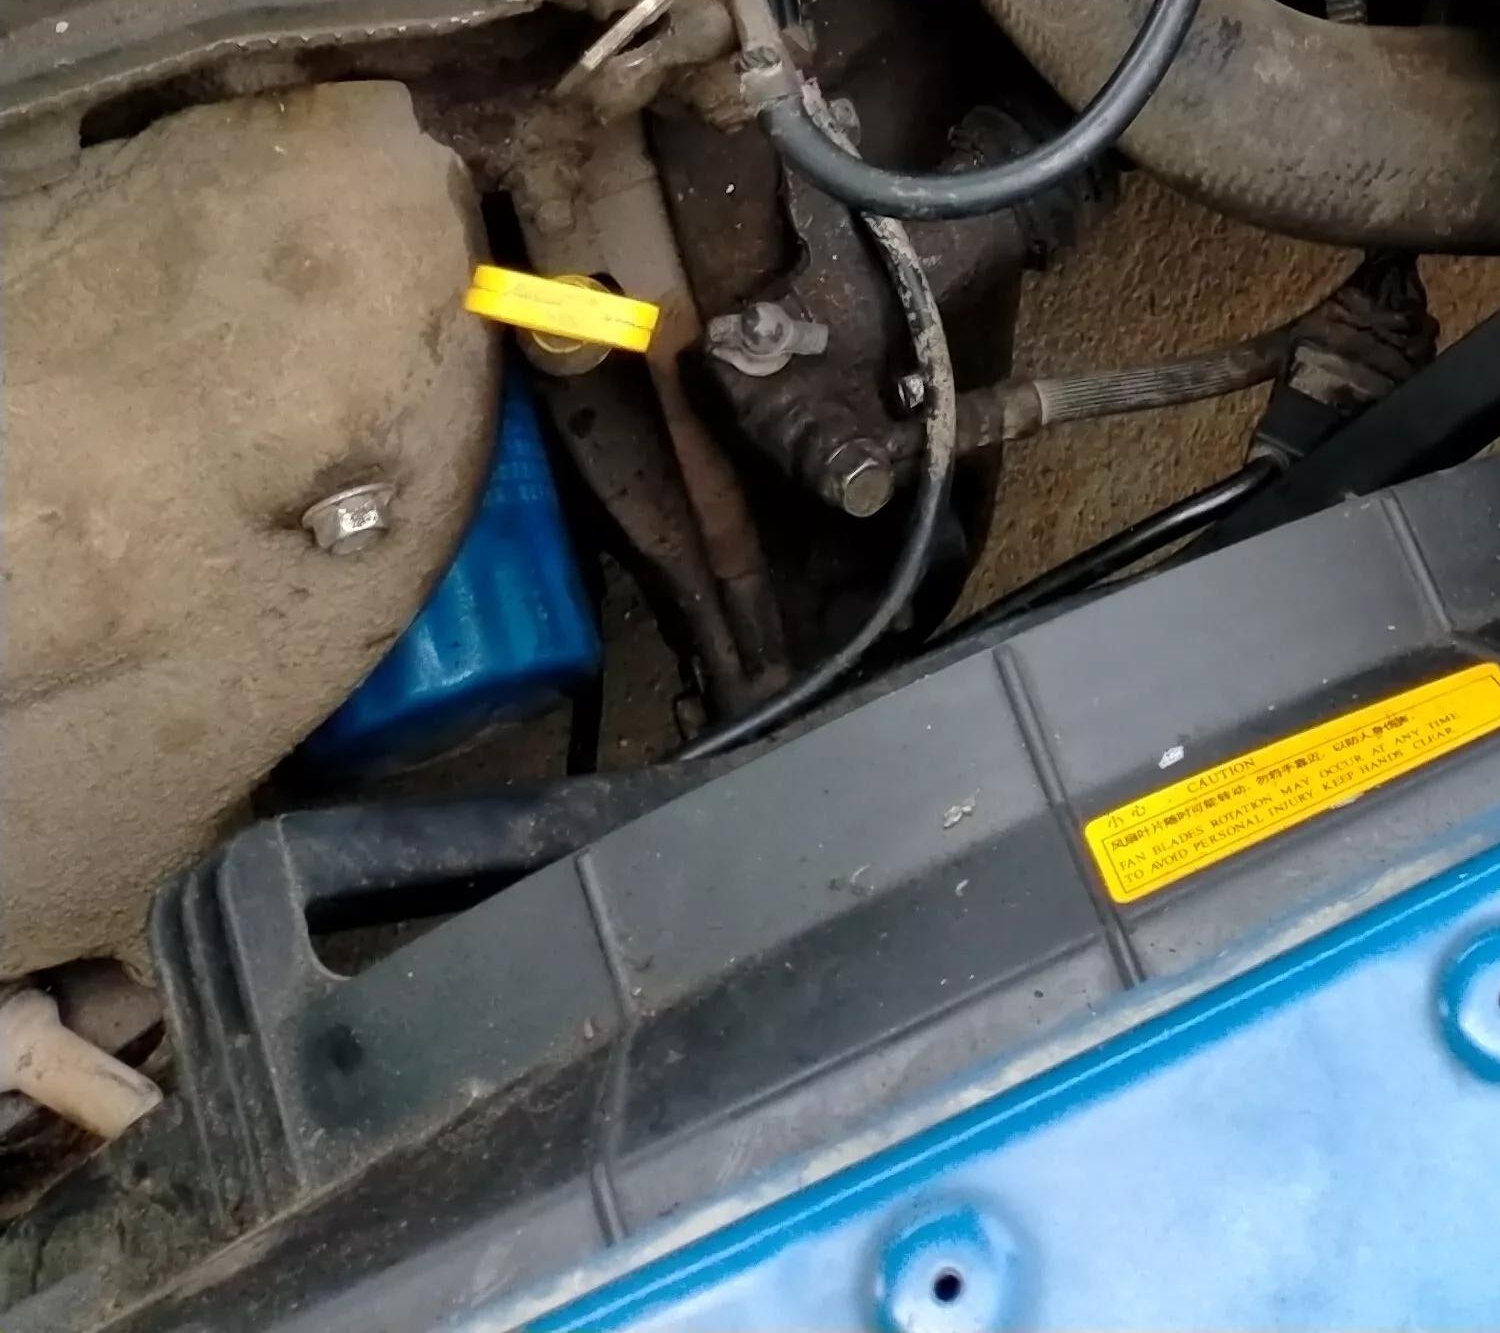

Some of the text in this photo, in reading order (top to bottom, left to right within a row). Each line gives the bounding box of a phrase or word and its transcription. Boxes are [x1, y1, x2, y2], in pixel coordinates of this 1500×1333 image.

[1118, 709, 1460, 872] FAN BLADES ROTATION MAY OCCUR AT ANY TIME
[1124, 724, 1456, 885] TO AVOID PERSONAL INJURY KEEP HANDS CLEAR
[1185, 756, 1257, 795] CAUTION
